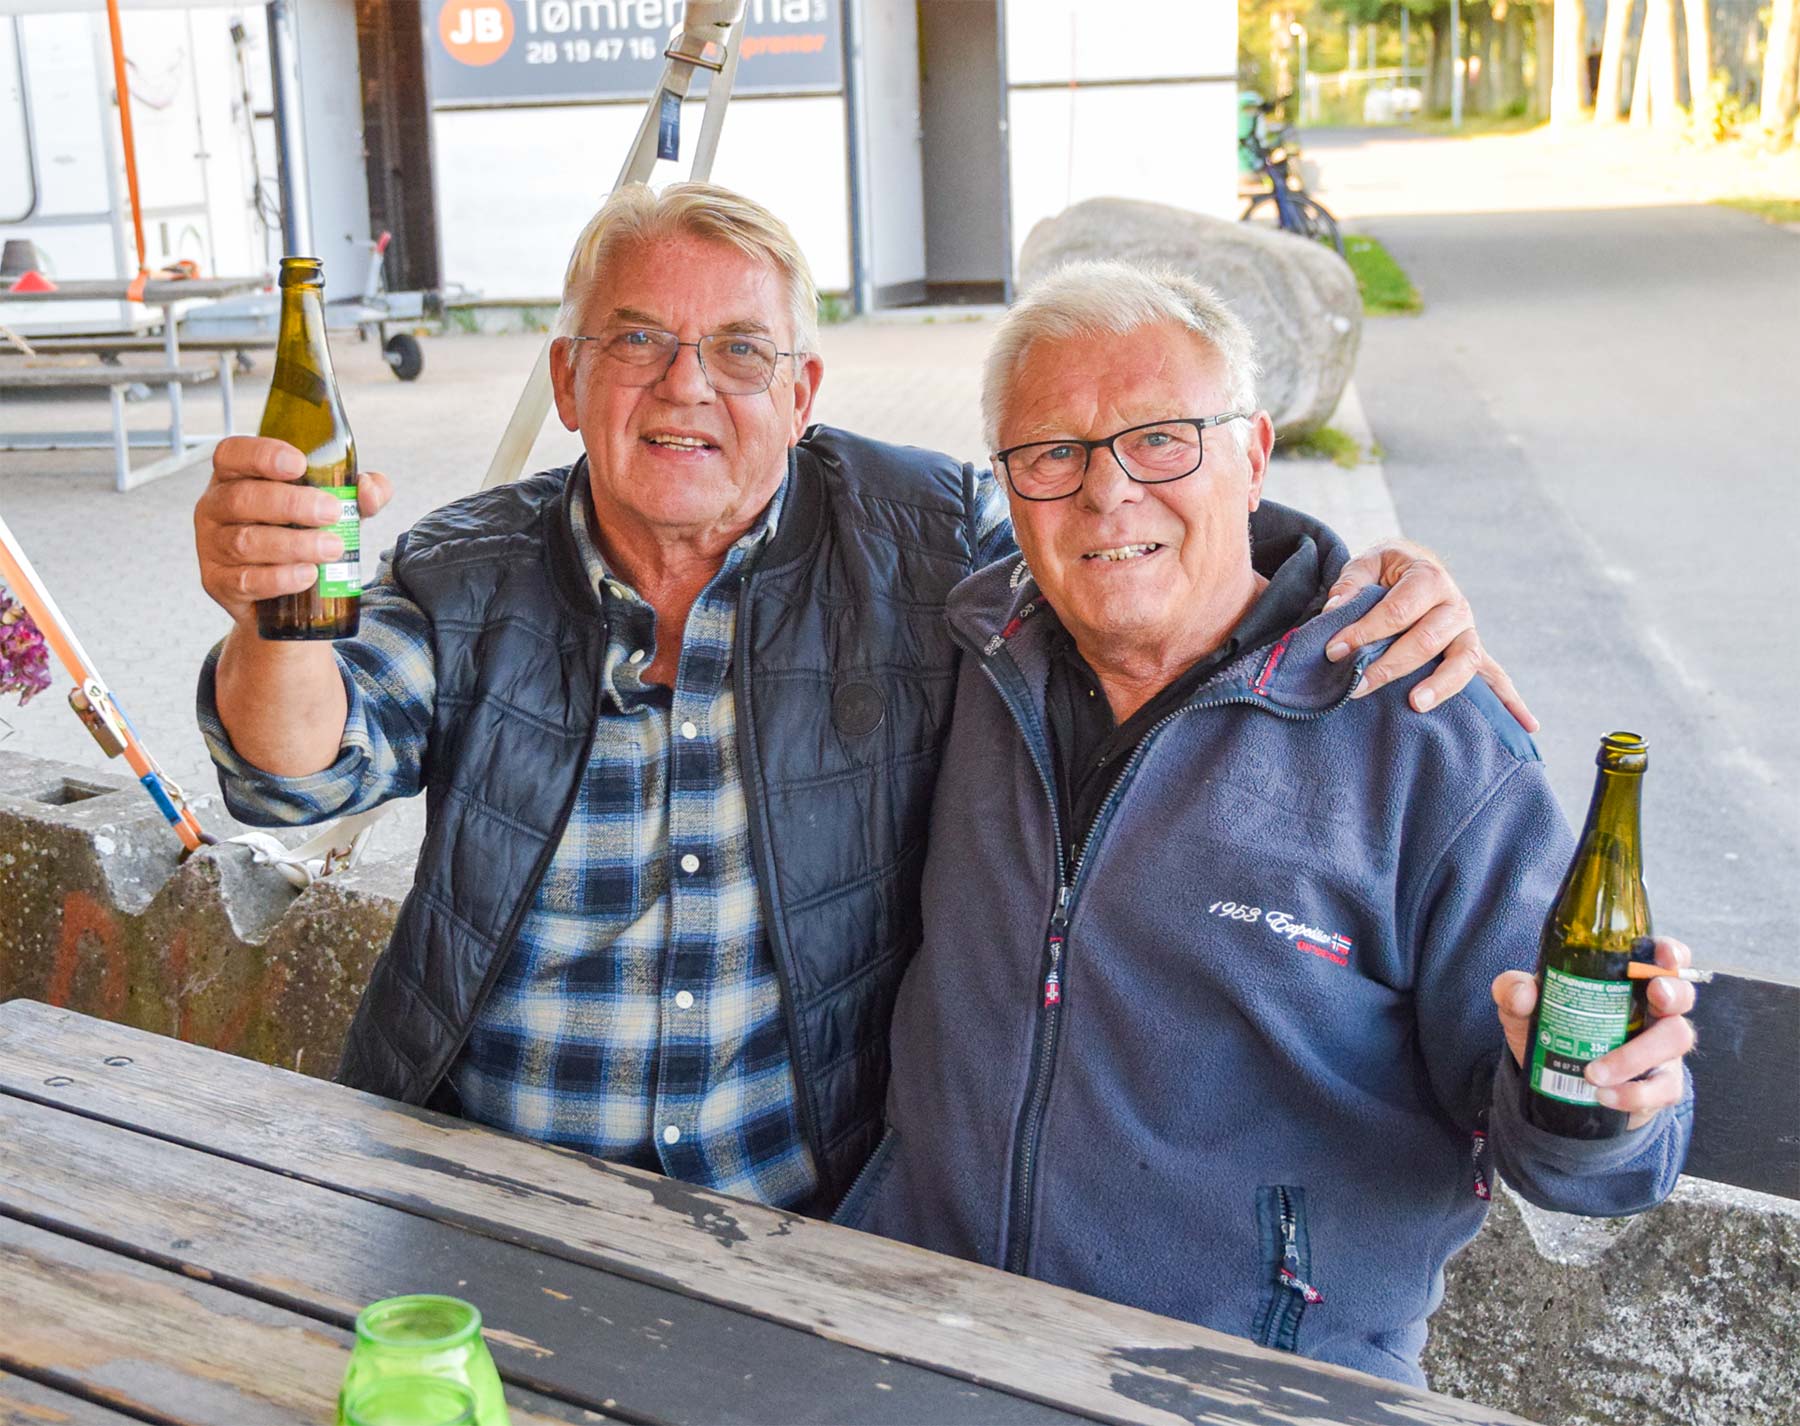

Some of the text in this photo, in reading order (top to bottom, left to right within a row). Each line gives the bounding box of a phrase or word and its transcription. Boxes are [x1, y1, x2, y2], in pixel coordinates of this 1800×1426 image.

[449, 8, 503, 44] JB
[526, 36, 656, 64] 28 19 47 16
